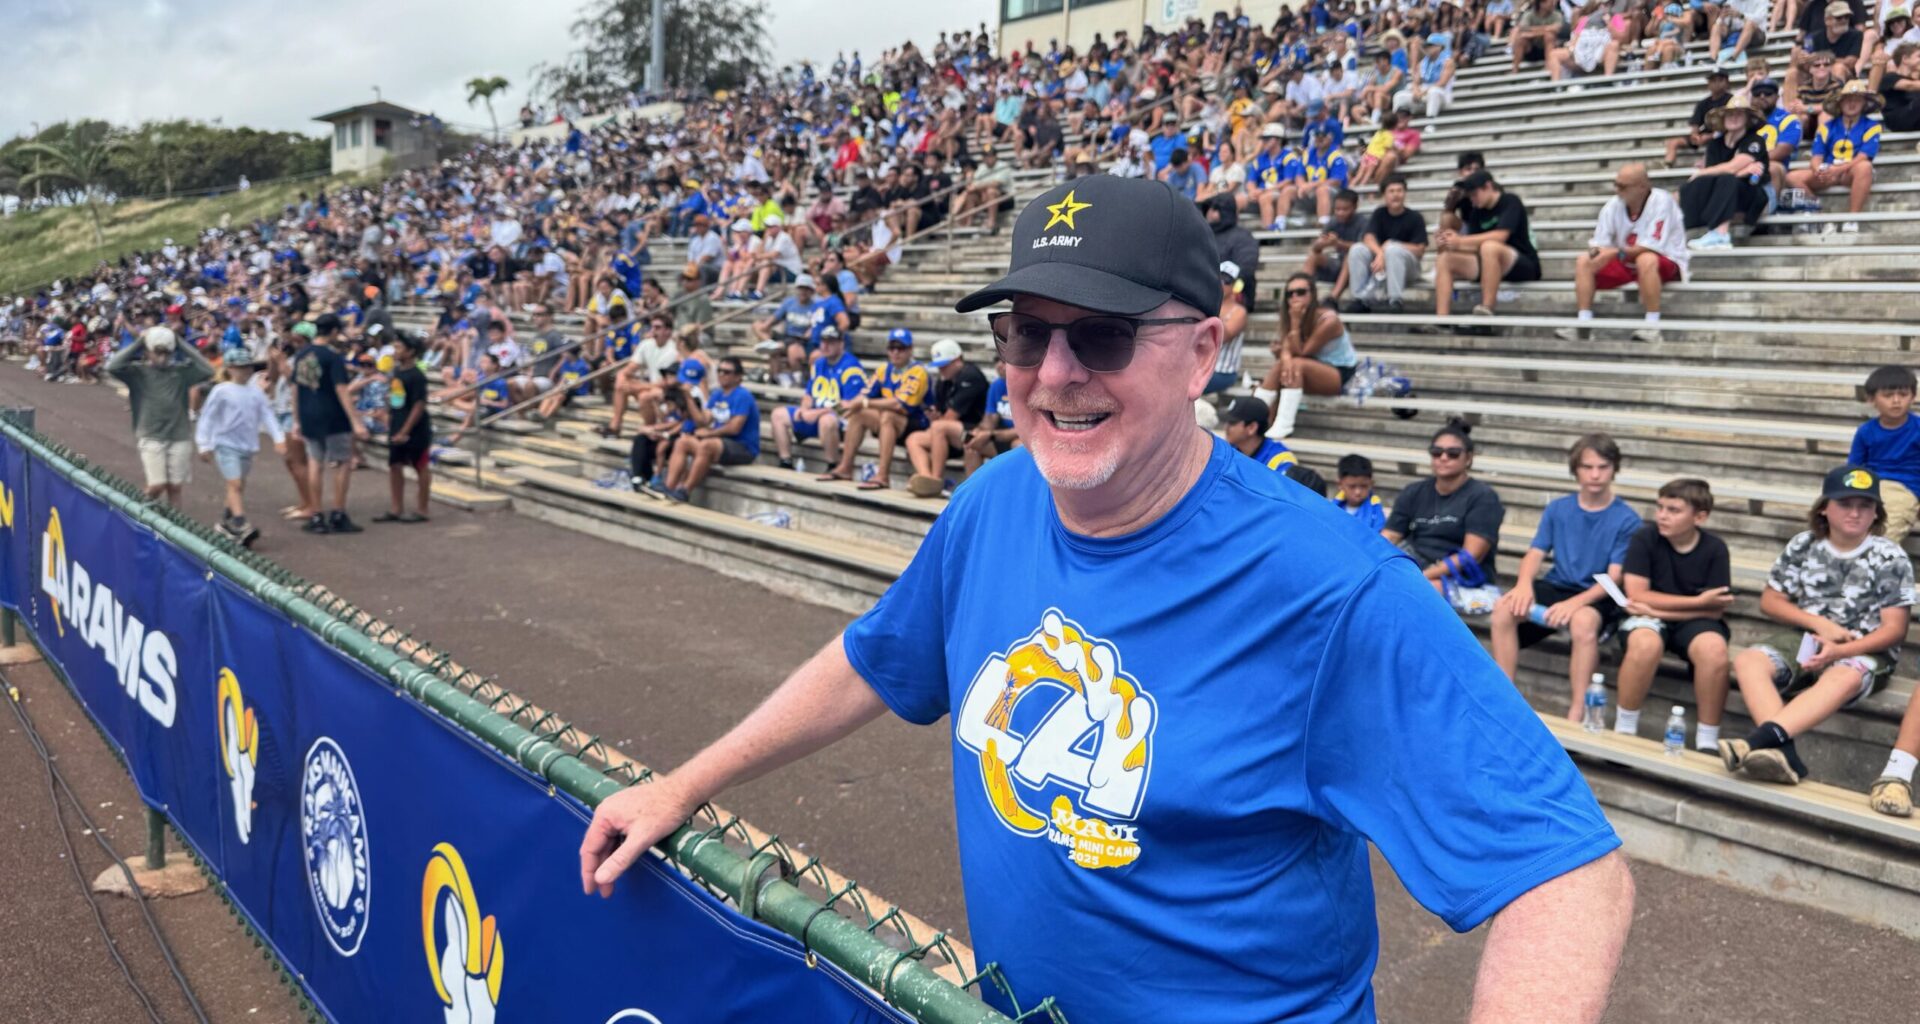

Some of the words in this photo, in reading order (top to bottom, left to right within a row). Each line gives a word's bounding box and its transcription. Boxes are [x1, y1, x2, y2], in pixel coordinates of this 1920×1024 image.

[1032, 236, 1049, 249] U.S.
[1049, 235, 1083, 247] ARMY
[41, 506, 72, 637] LA
[70, 560, 177, 728] RAMS
[957, 606, 1158, 838] LA
[1051, 807, 1139, 842] MAUI
[1048, 828, 1076, 849] RAMS
[1078, 839, 1105, 855] MINI
[1106, 844, 1142, 859] CAMP
[1068, 849, 1100, 866] 2025
